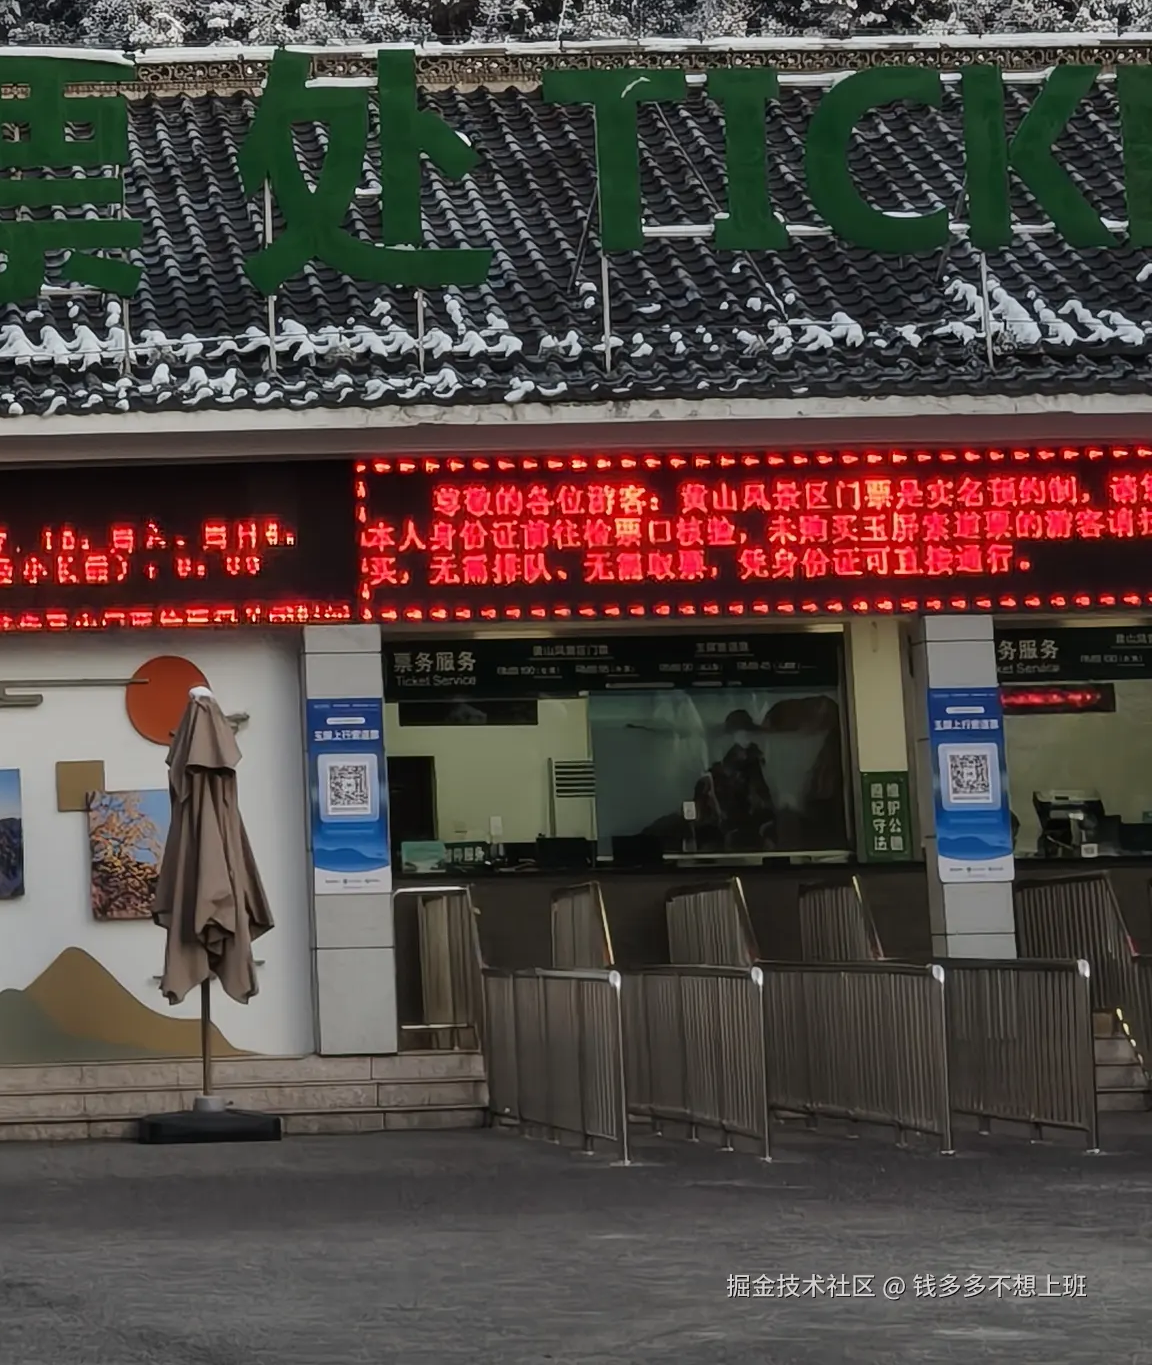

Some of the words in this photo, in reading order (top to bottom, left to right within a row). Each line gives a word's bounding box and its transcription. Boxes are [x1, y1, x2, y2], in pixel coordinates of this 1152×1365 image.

[394, 651, 477, 673] 票务服务
[395, 675, 431, 687] Ticket
[433, 674, 477, 686] Service
